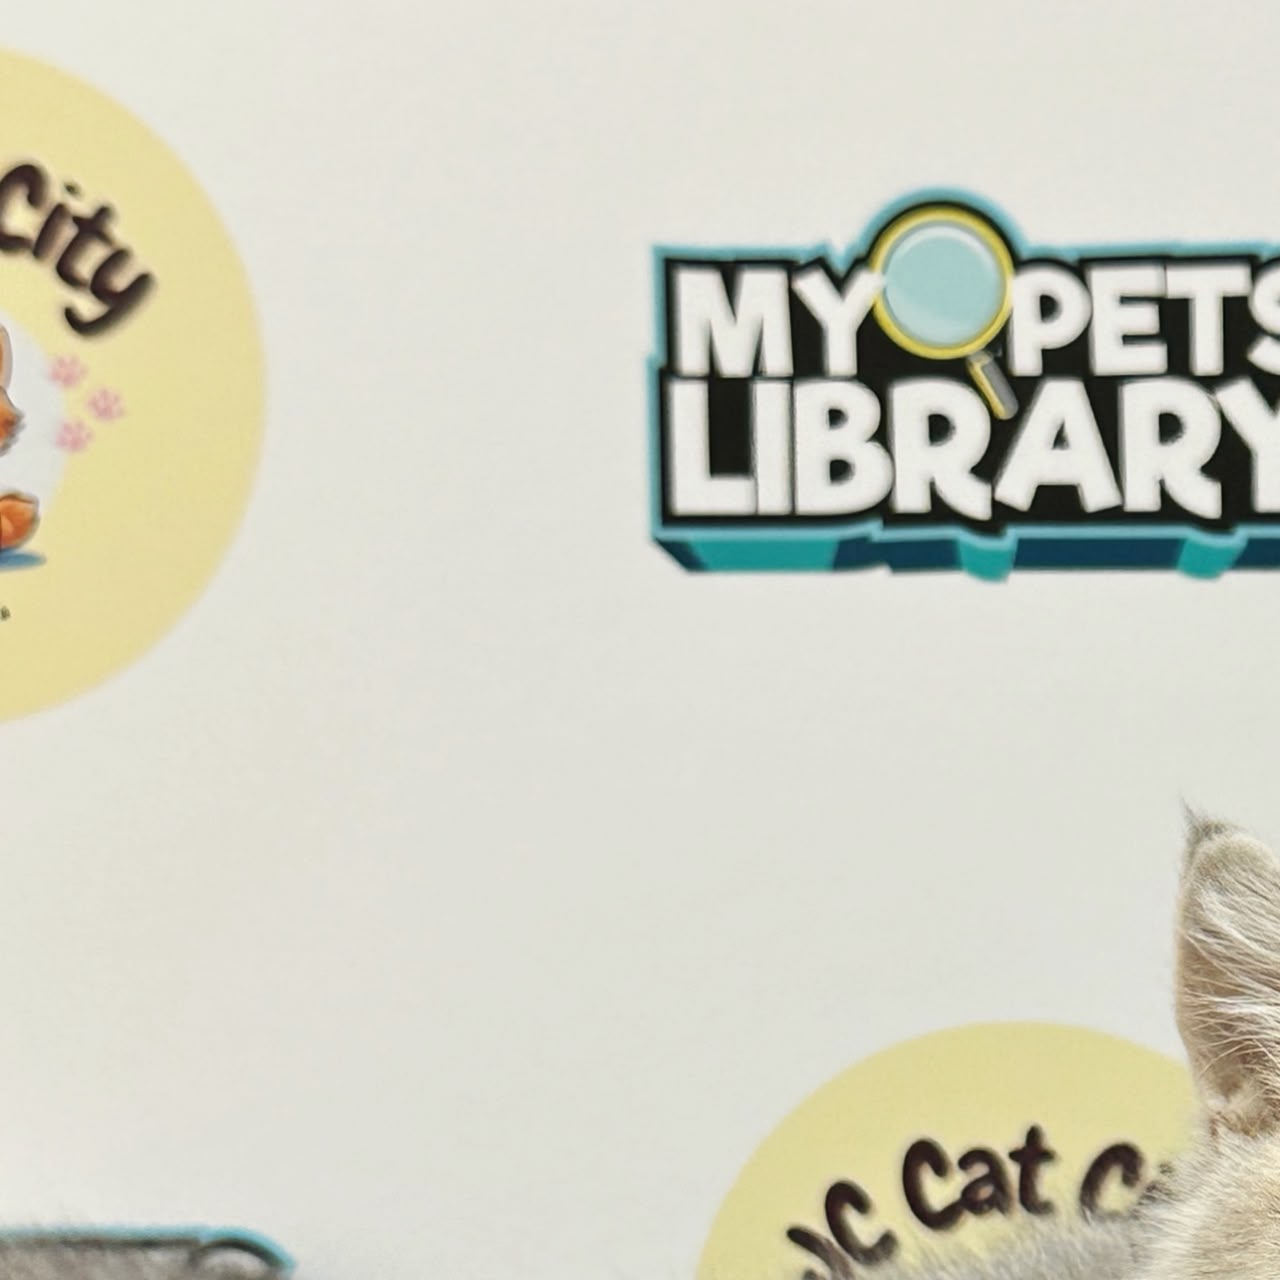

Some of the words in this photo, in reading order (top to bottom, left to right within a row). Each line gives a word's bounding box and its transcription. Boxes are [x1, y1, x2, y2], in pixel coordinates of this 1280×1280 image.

[0, 163, 156, 336] City
[672, 263, 884, 377] MY
[903, 1124, 1056, 1231] Cat
